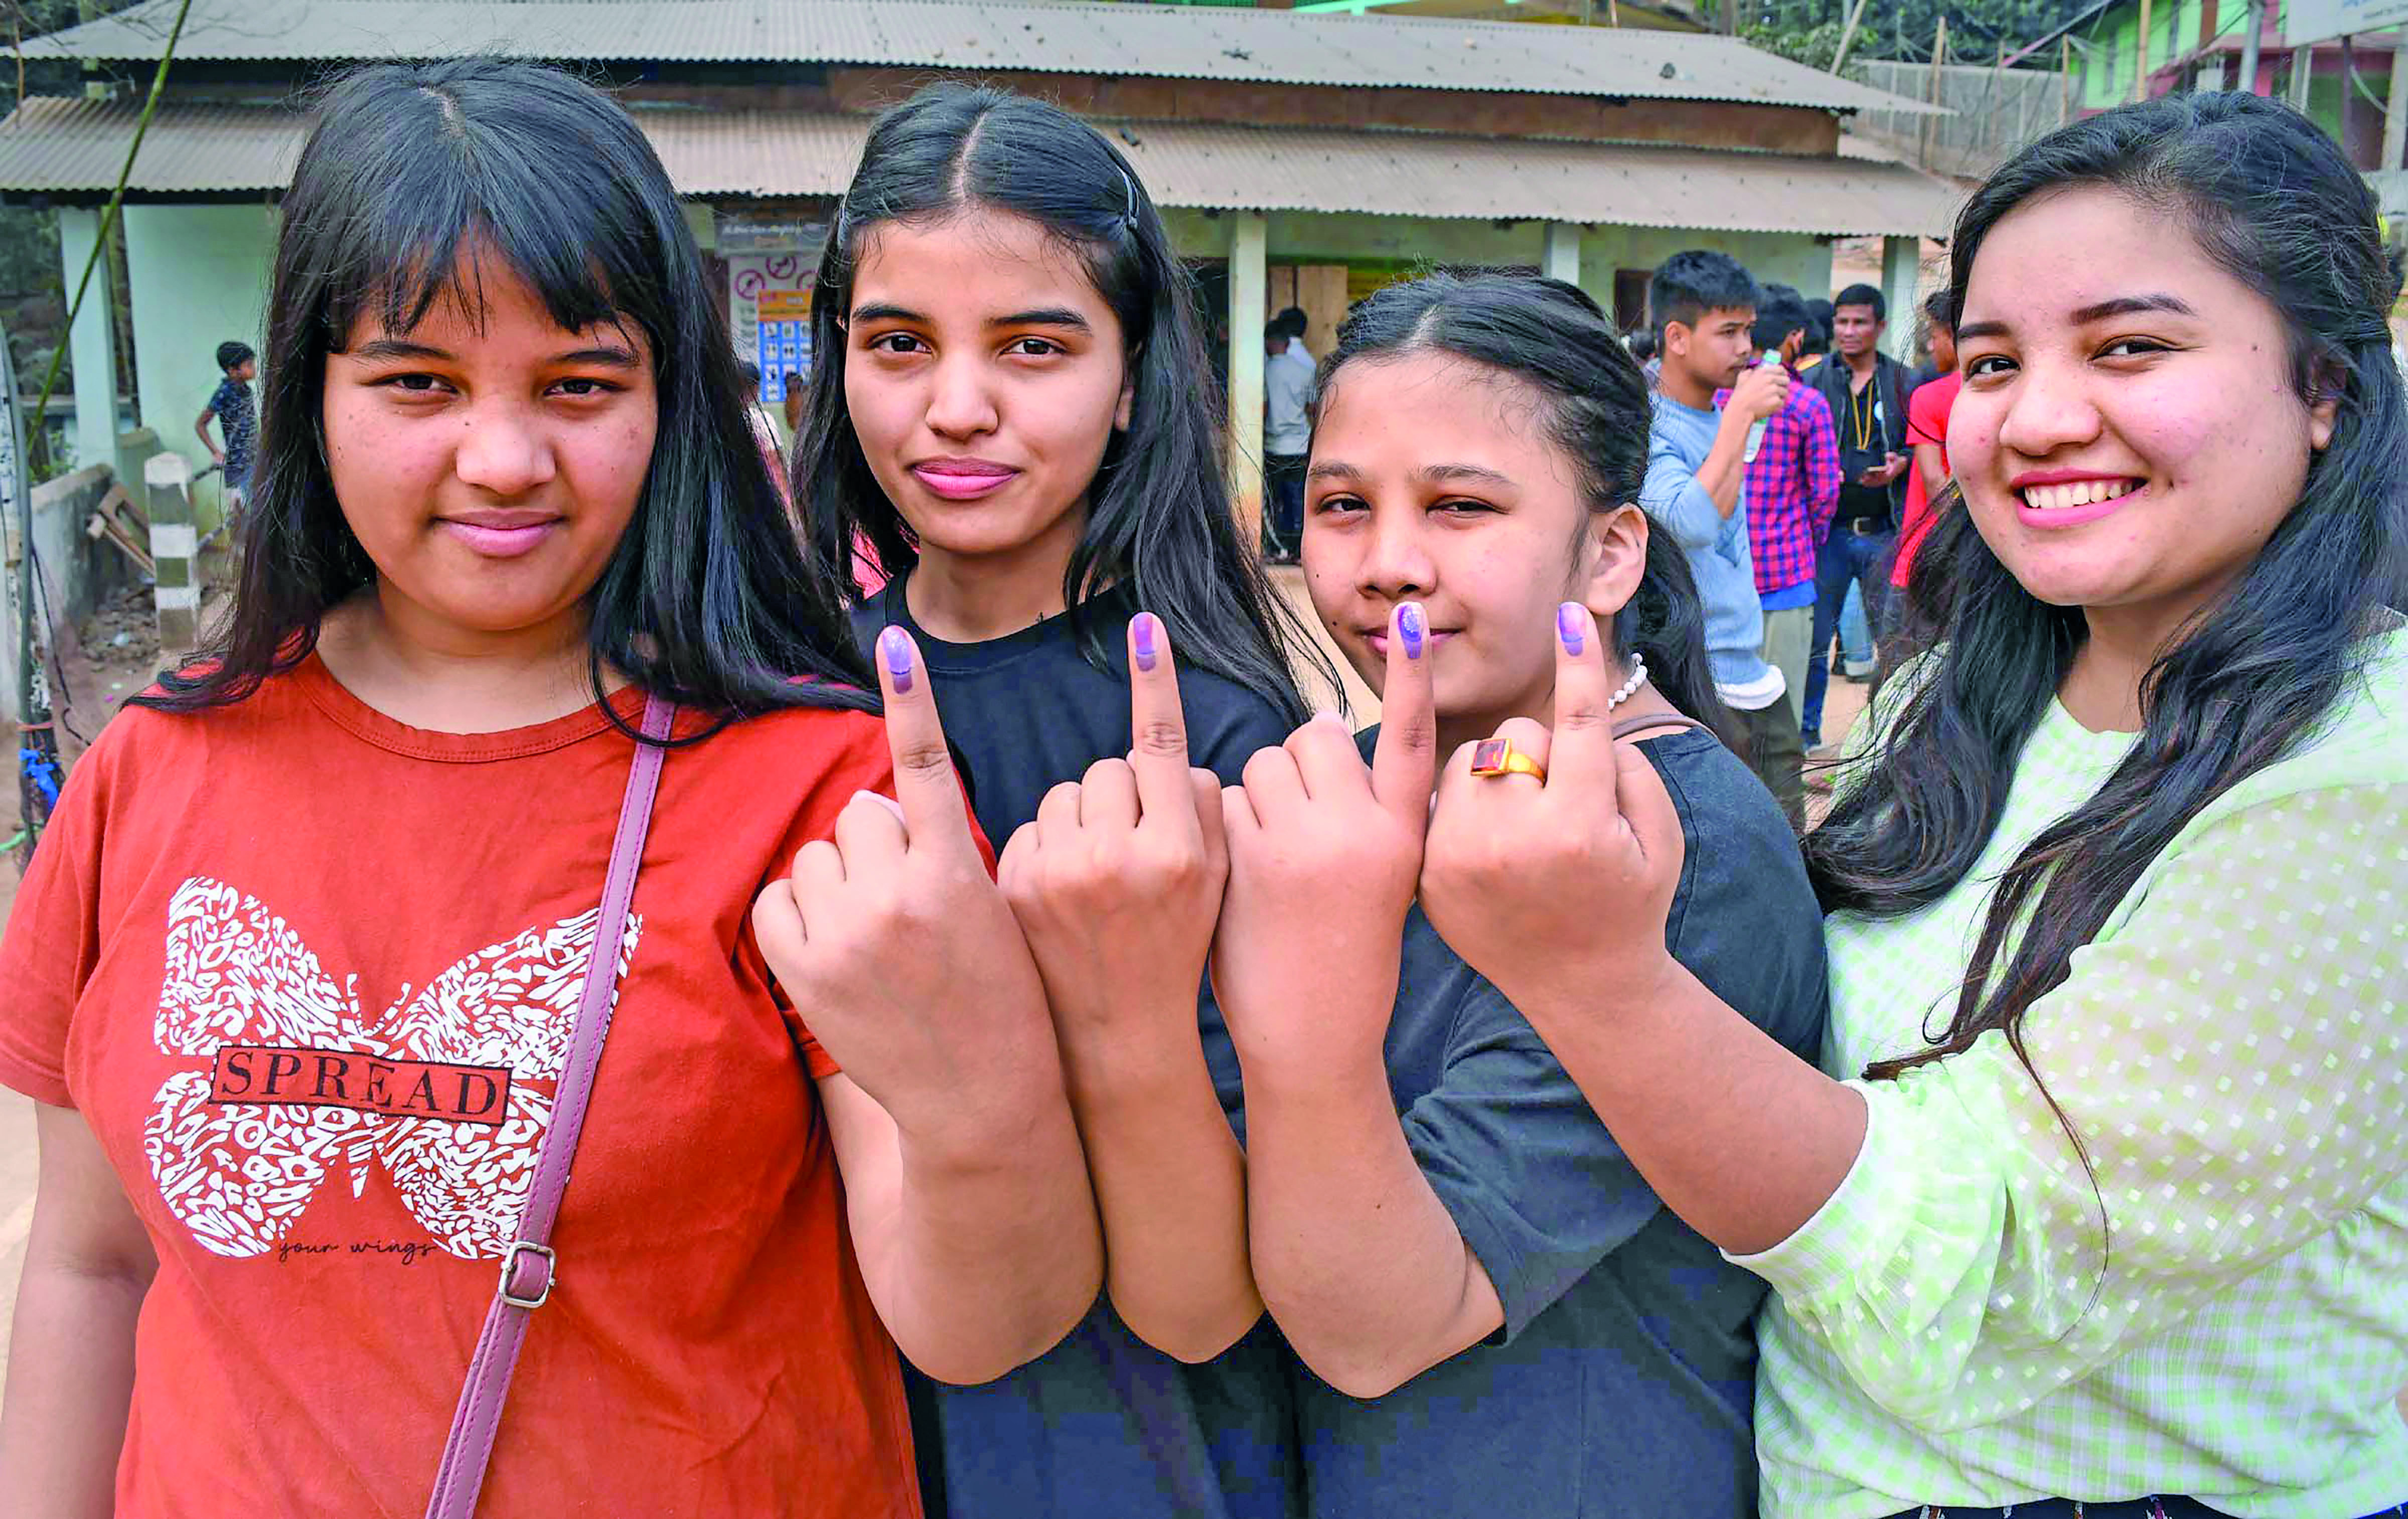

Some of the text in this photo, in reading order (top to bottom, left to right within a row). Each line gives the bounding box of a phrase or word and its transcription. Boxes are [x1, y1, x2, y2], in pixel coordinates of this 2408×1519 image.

[222, 1052, 497, 1115] SPREAD
[279, 1240, 437, 1265] your wings
